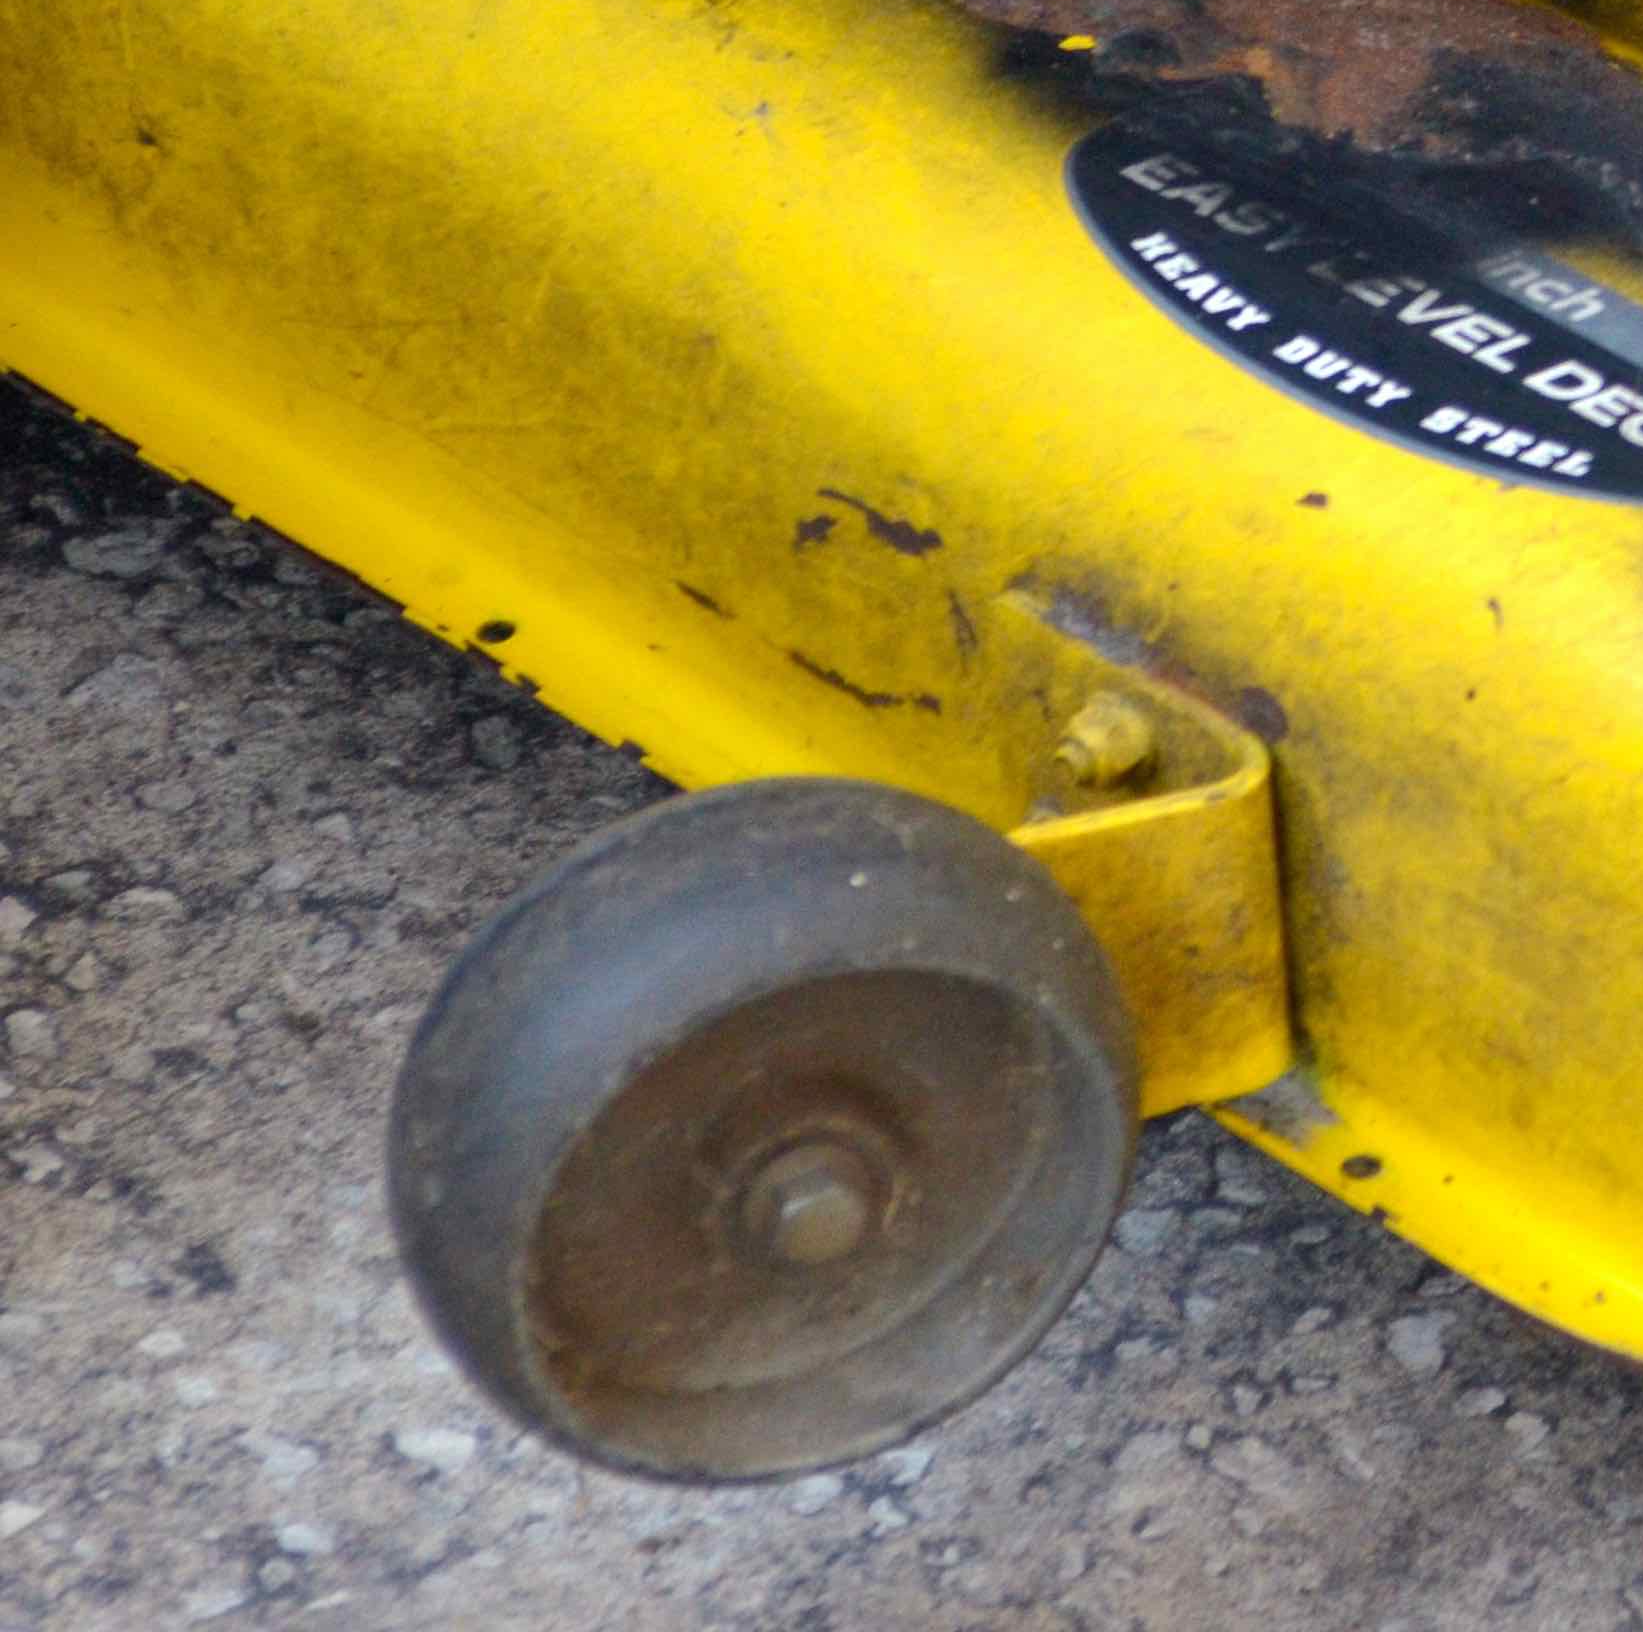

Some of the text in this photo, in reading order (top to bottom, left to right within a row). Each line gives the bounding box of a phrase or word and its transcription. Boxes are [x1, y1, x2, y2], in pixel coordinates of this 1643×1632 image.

[1130, 232, 1594, 477] HEAVY DUTY STEEL
